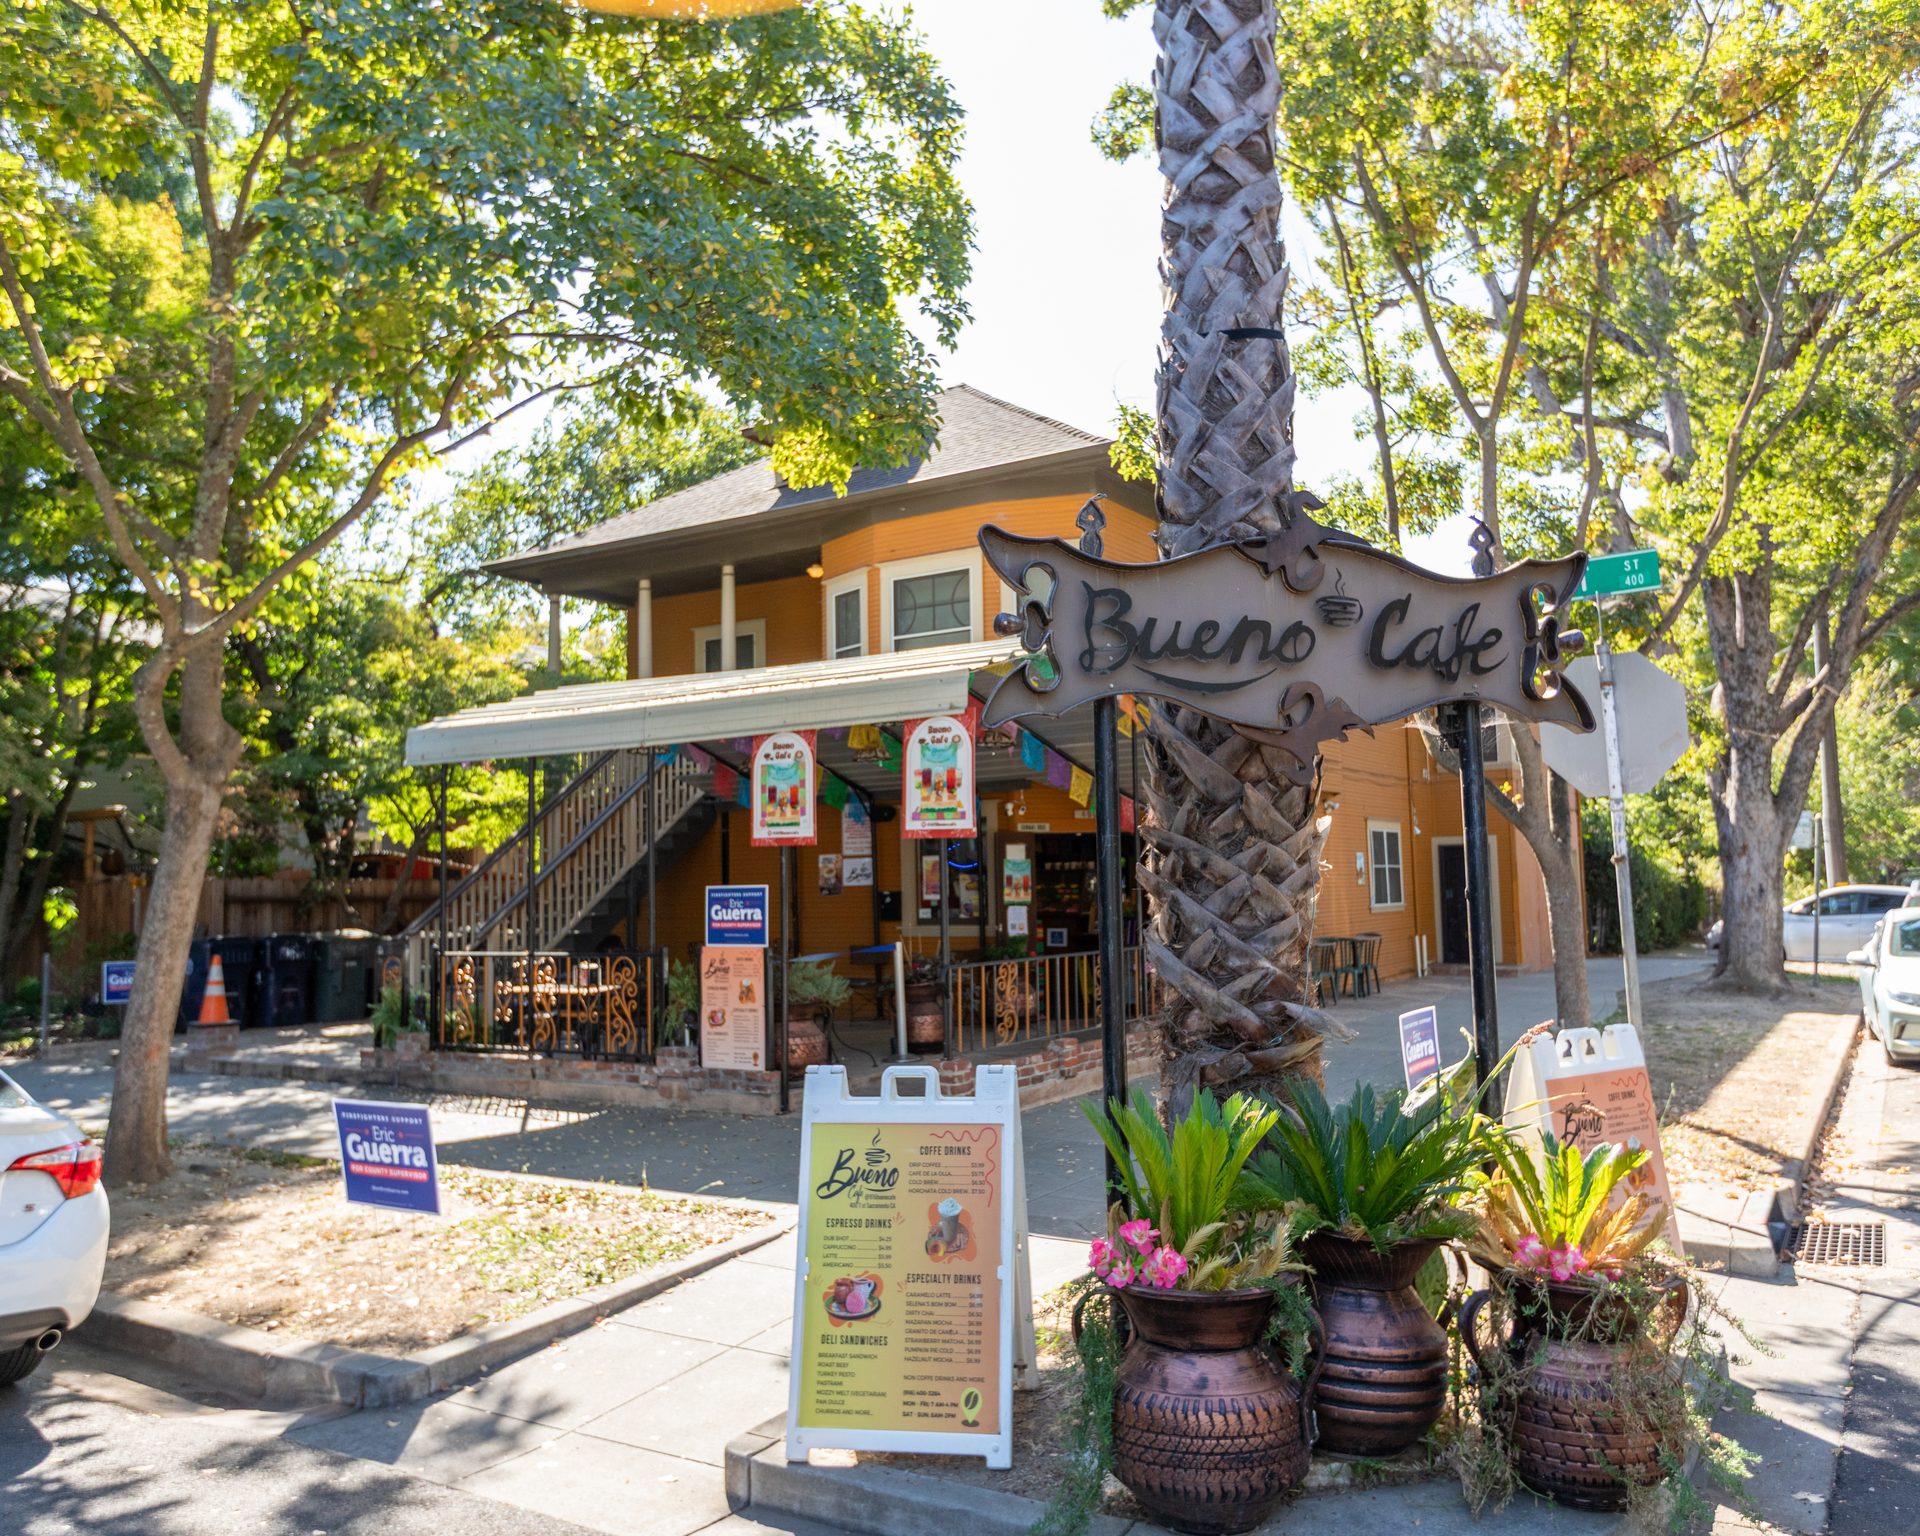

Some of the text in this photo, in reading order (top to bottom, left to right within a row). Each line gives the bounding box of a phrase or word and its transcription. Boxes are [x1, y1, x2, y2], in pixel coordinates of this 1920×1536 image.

[1624, 559, 1639, 571] ST
[1625, 573, 1644, 586] 400
[1078, 579, 1508, 684] Bueno Cafe
[928, 726, 952, 734] Bueno
[772, 742, 794, 750] Bueno
[729, 898, 743, 908] Eric
[711, 904, 762, 920] Guerra
[1406, 1039, 1435, 1063] Guerra
[342, 1111, 422, 1125] FIREFIGHTERS SUPPORT
[372, 1125, 395, 1142] Eric
[346, 1132, 429, 1168] Guerra
[920, 1146, 971, 1156] COFFE DRINKS
[365, 1166, 388, 1175] COUNTY
[389, 1168, 427, 1179] SUPERVISOR
[816, 1148, 899, 1199] Bueno
[826, 1218, 892, 1228] ESPRESSO DRINKS
[907, 1273, 981, 1284] ESPECIALTY DRINKS
[821, 1334, 888, 1346] DELI SANDWICHES
